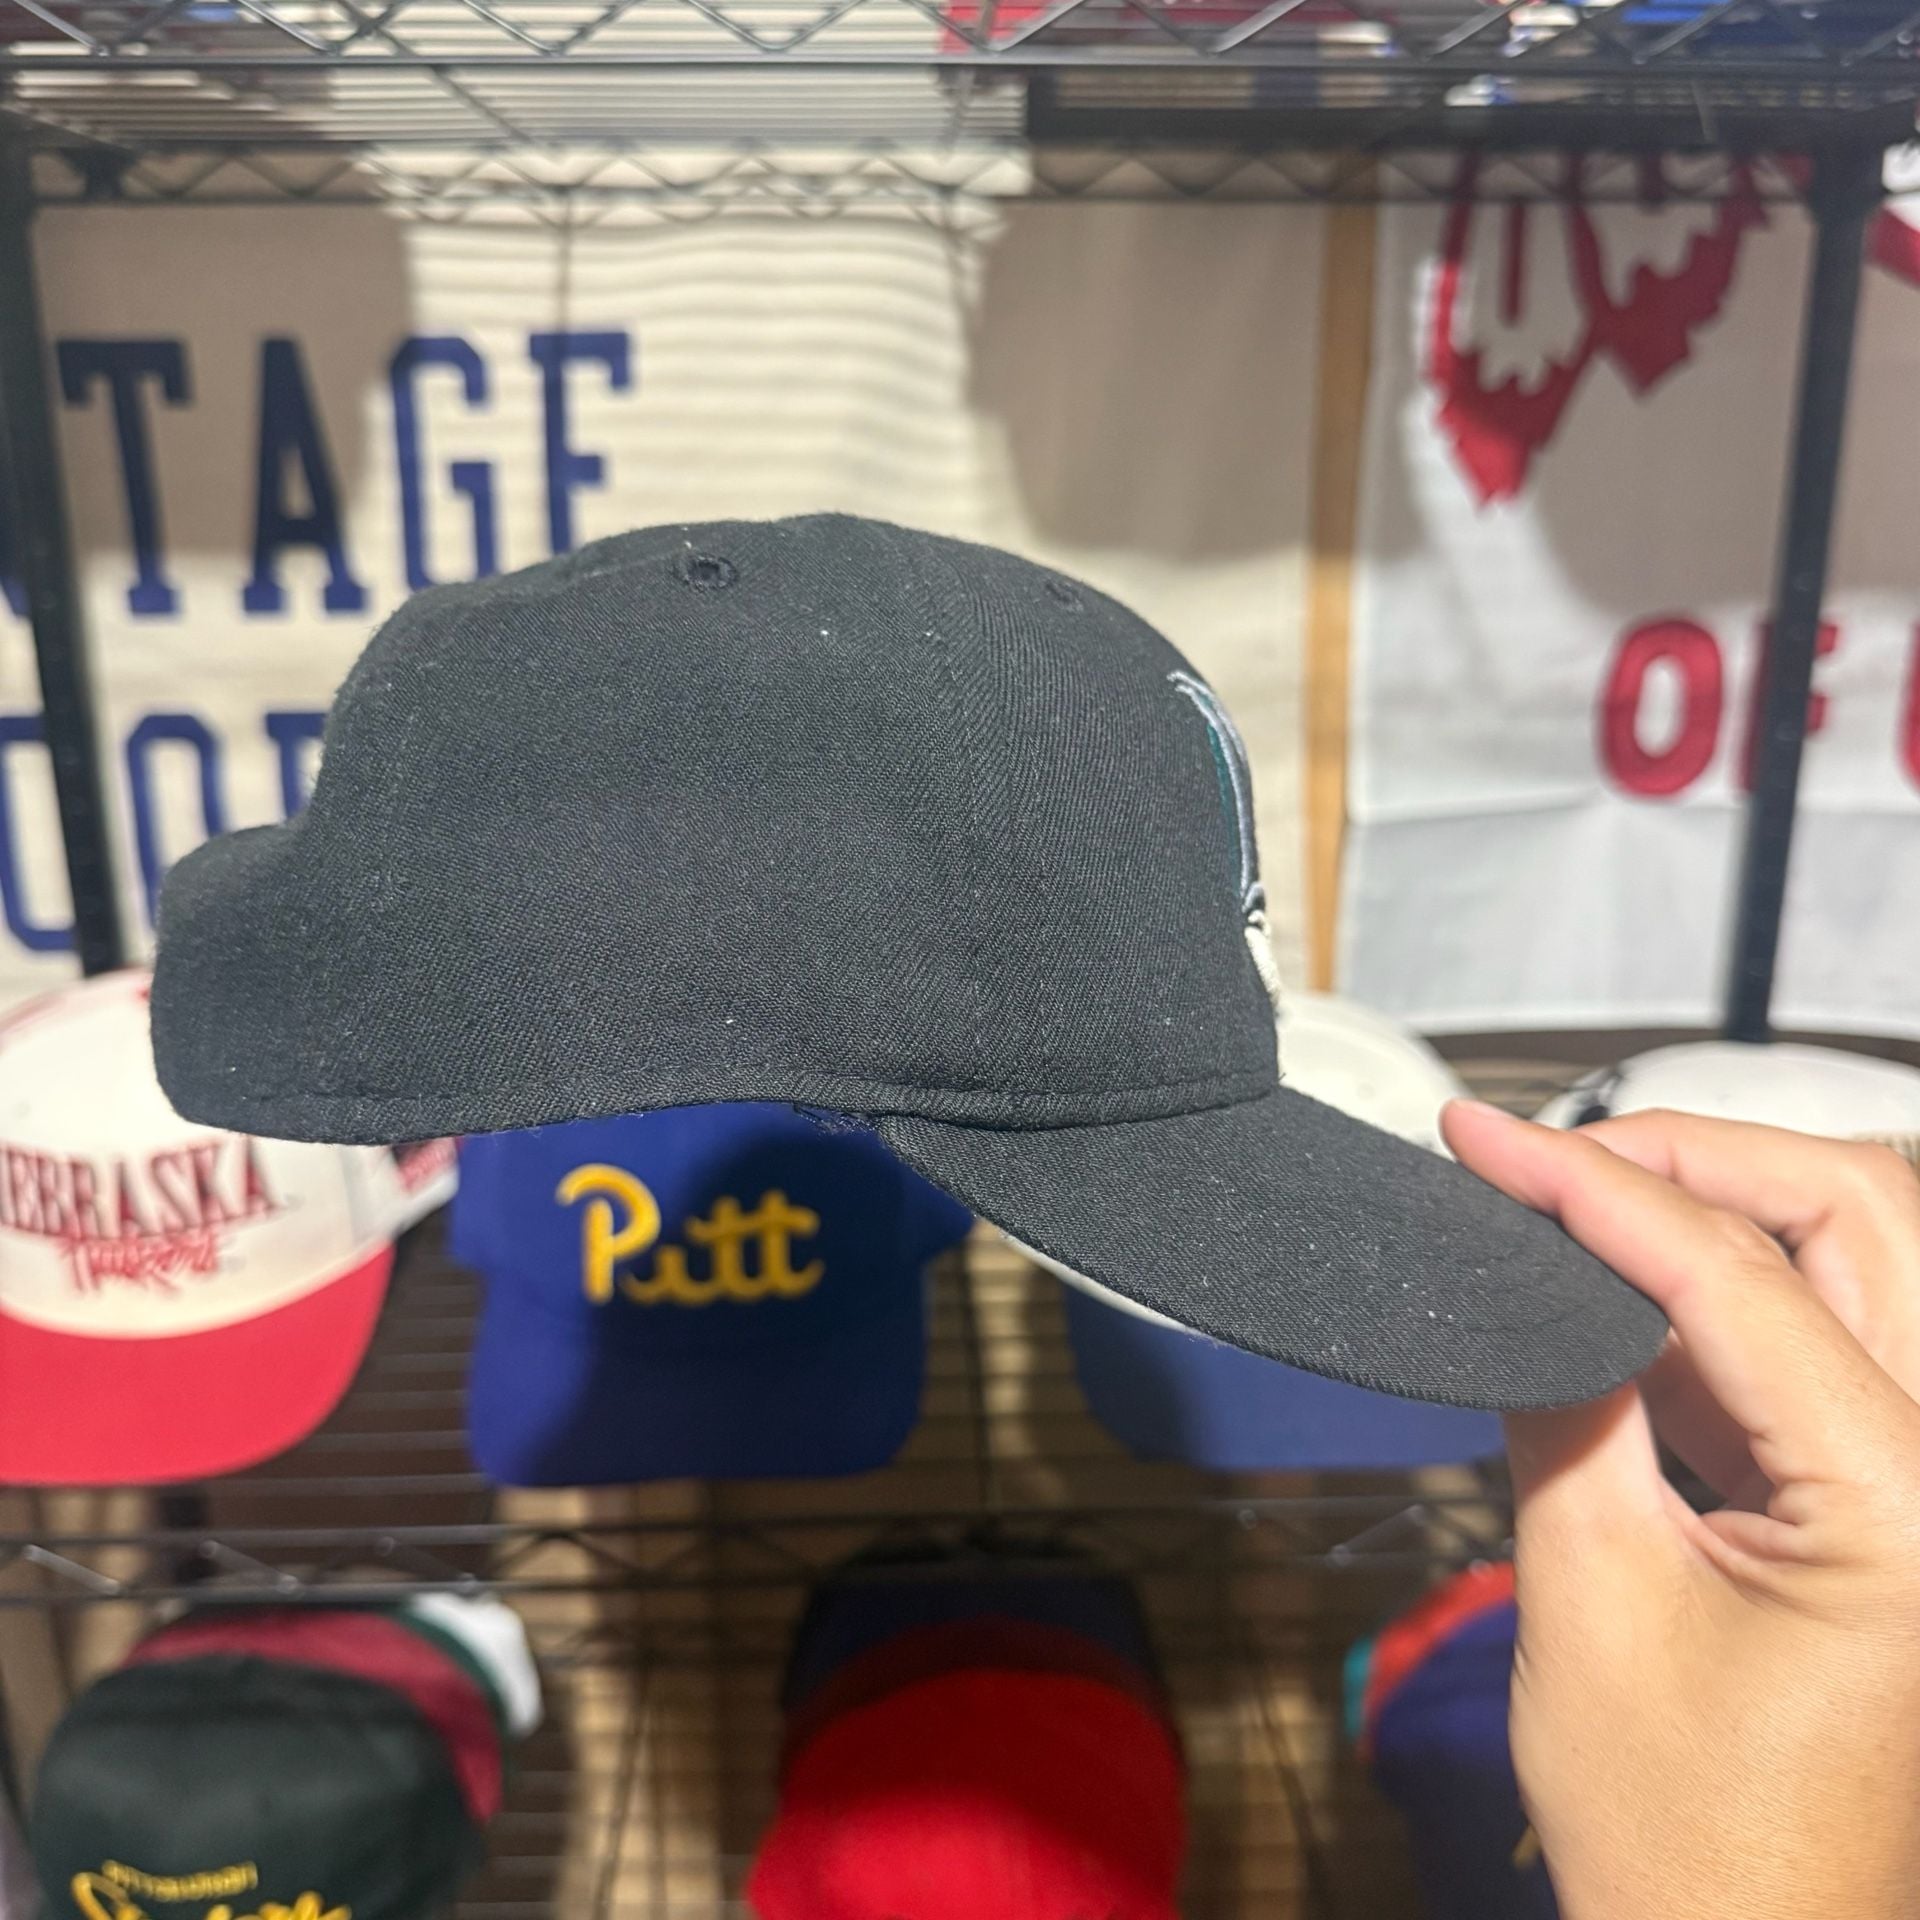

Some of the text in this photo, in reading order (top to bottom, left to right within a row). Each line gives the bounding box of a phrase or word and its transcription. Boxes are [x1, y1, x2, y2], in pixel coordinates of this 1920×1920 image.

[0, 331, 631, 620] TAGE
[0, 1138, 281, 1240] EBRASKA
[556, 1164, 824, 1304] Pitt
